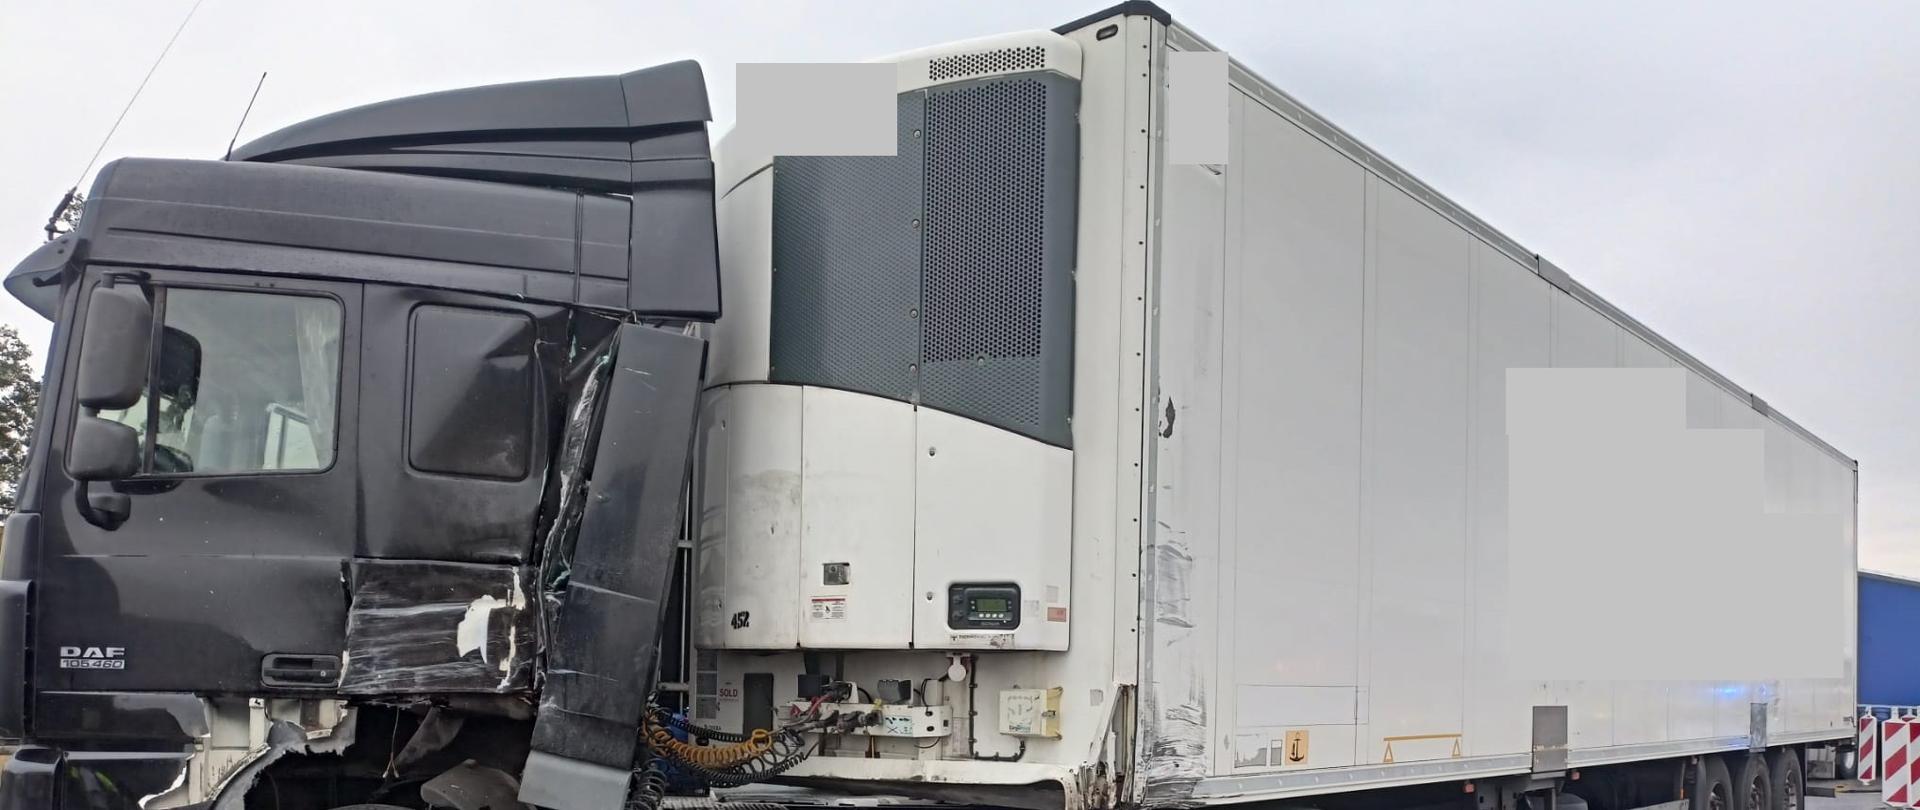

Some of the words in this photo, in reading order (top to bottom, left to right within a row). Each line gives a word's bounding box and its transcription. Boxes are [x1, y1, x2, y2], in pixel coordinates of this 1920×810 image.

[731, 611, 750, 630] 452
[60, 646, 125, 658] DAF
[719, 688, 738, 698] SOLD
